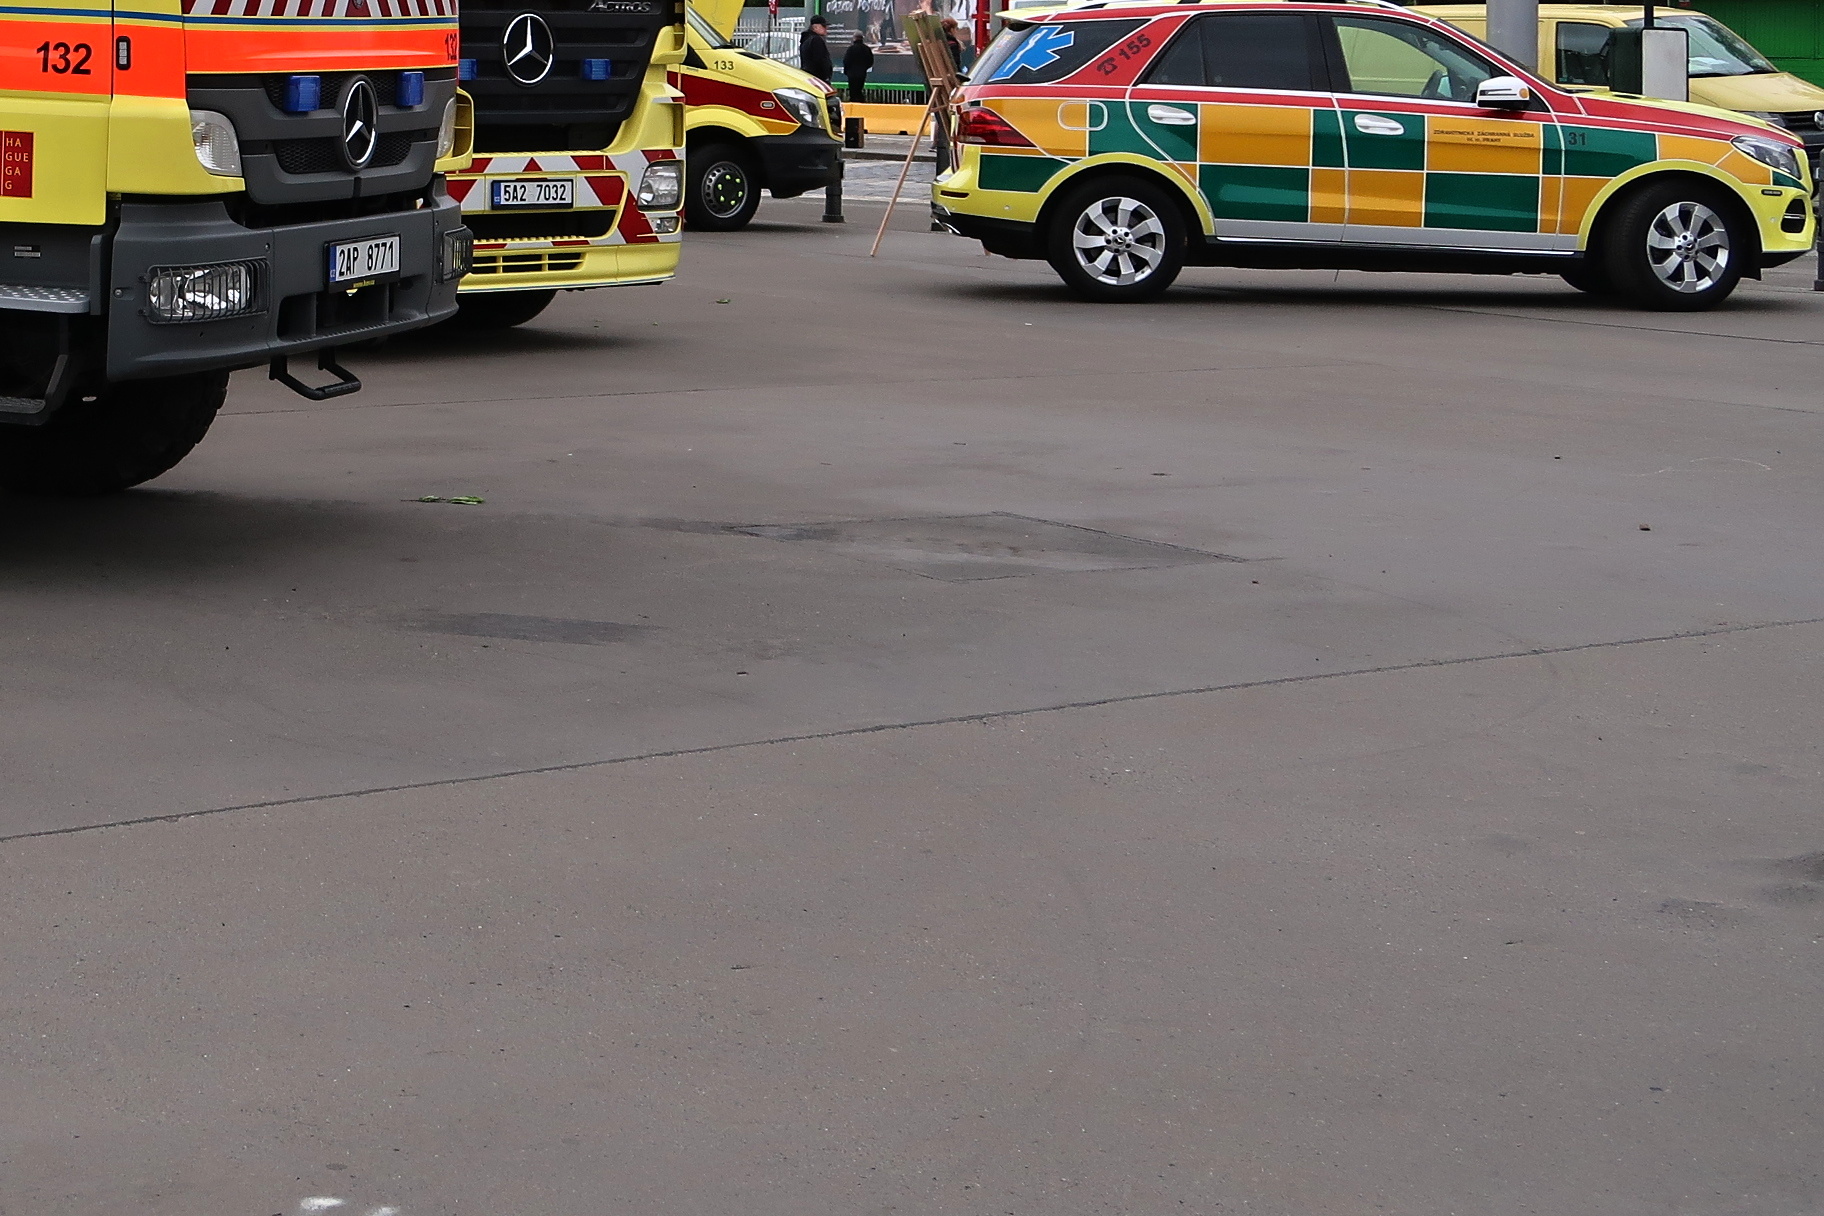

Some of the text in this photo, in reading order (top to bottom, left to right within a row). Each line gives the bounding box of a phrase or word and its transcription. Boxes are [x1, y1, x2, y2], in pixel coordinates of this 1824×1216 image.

[1119, 33, 1151, 60] 155
[36, 41, 92, 75] 132
[714, 61, 734, 70] 133
[1569, 132, 1587, 145] 31
[504, 184, 566, 202] 5A2 7032
[339, 247, 359, 277] 2AP
[367, 241, 394, 271] 8771
